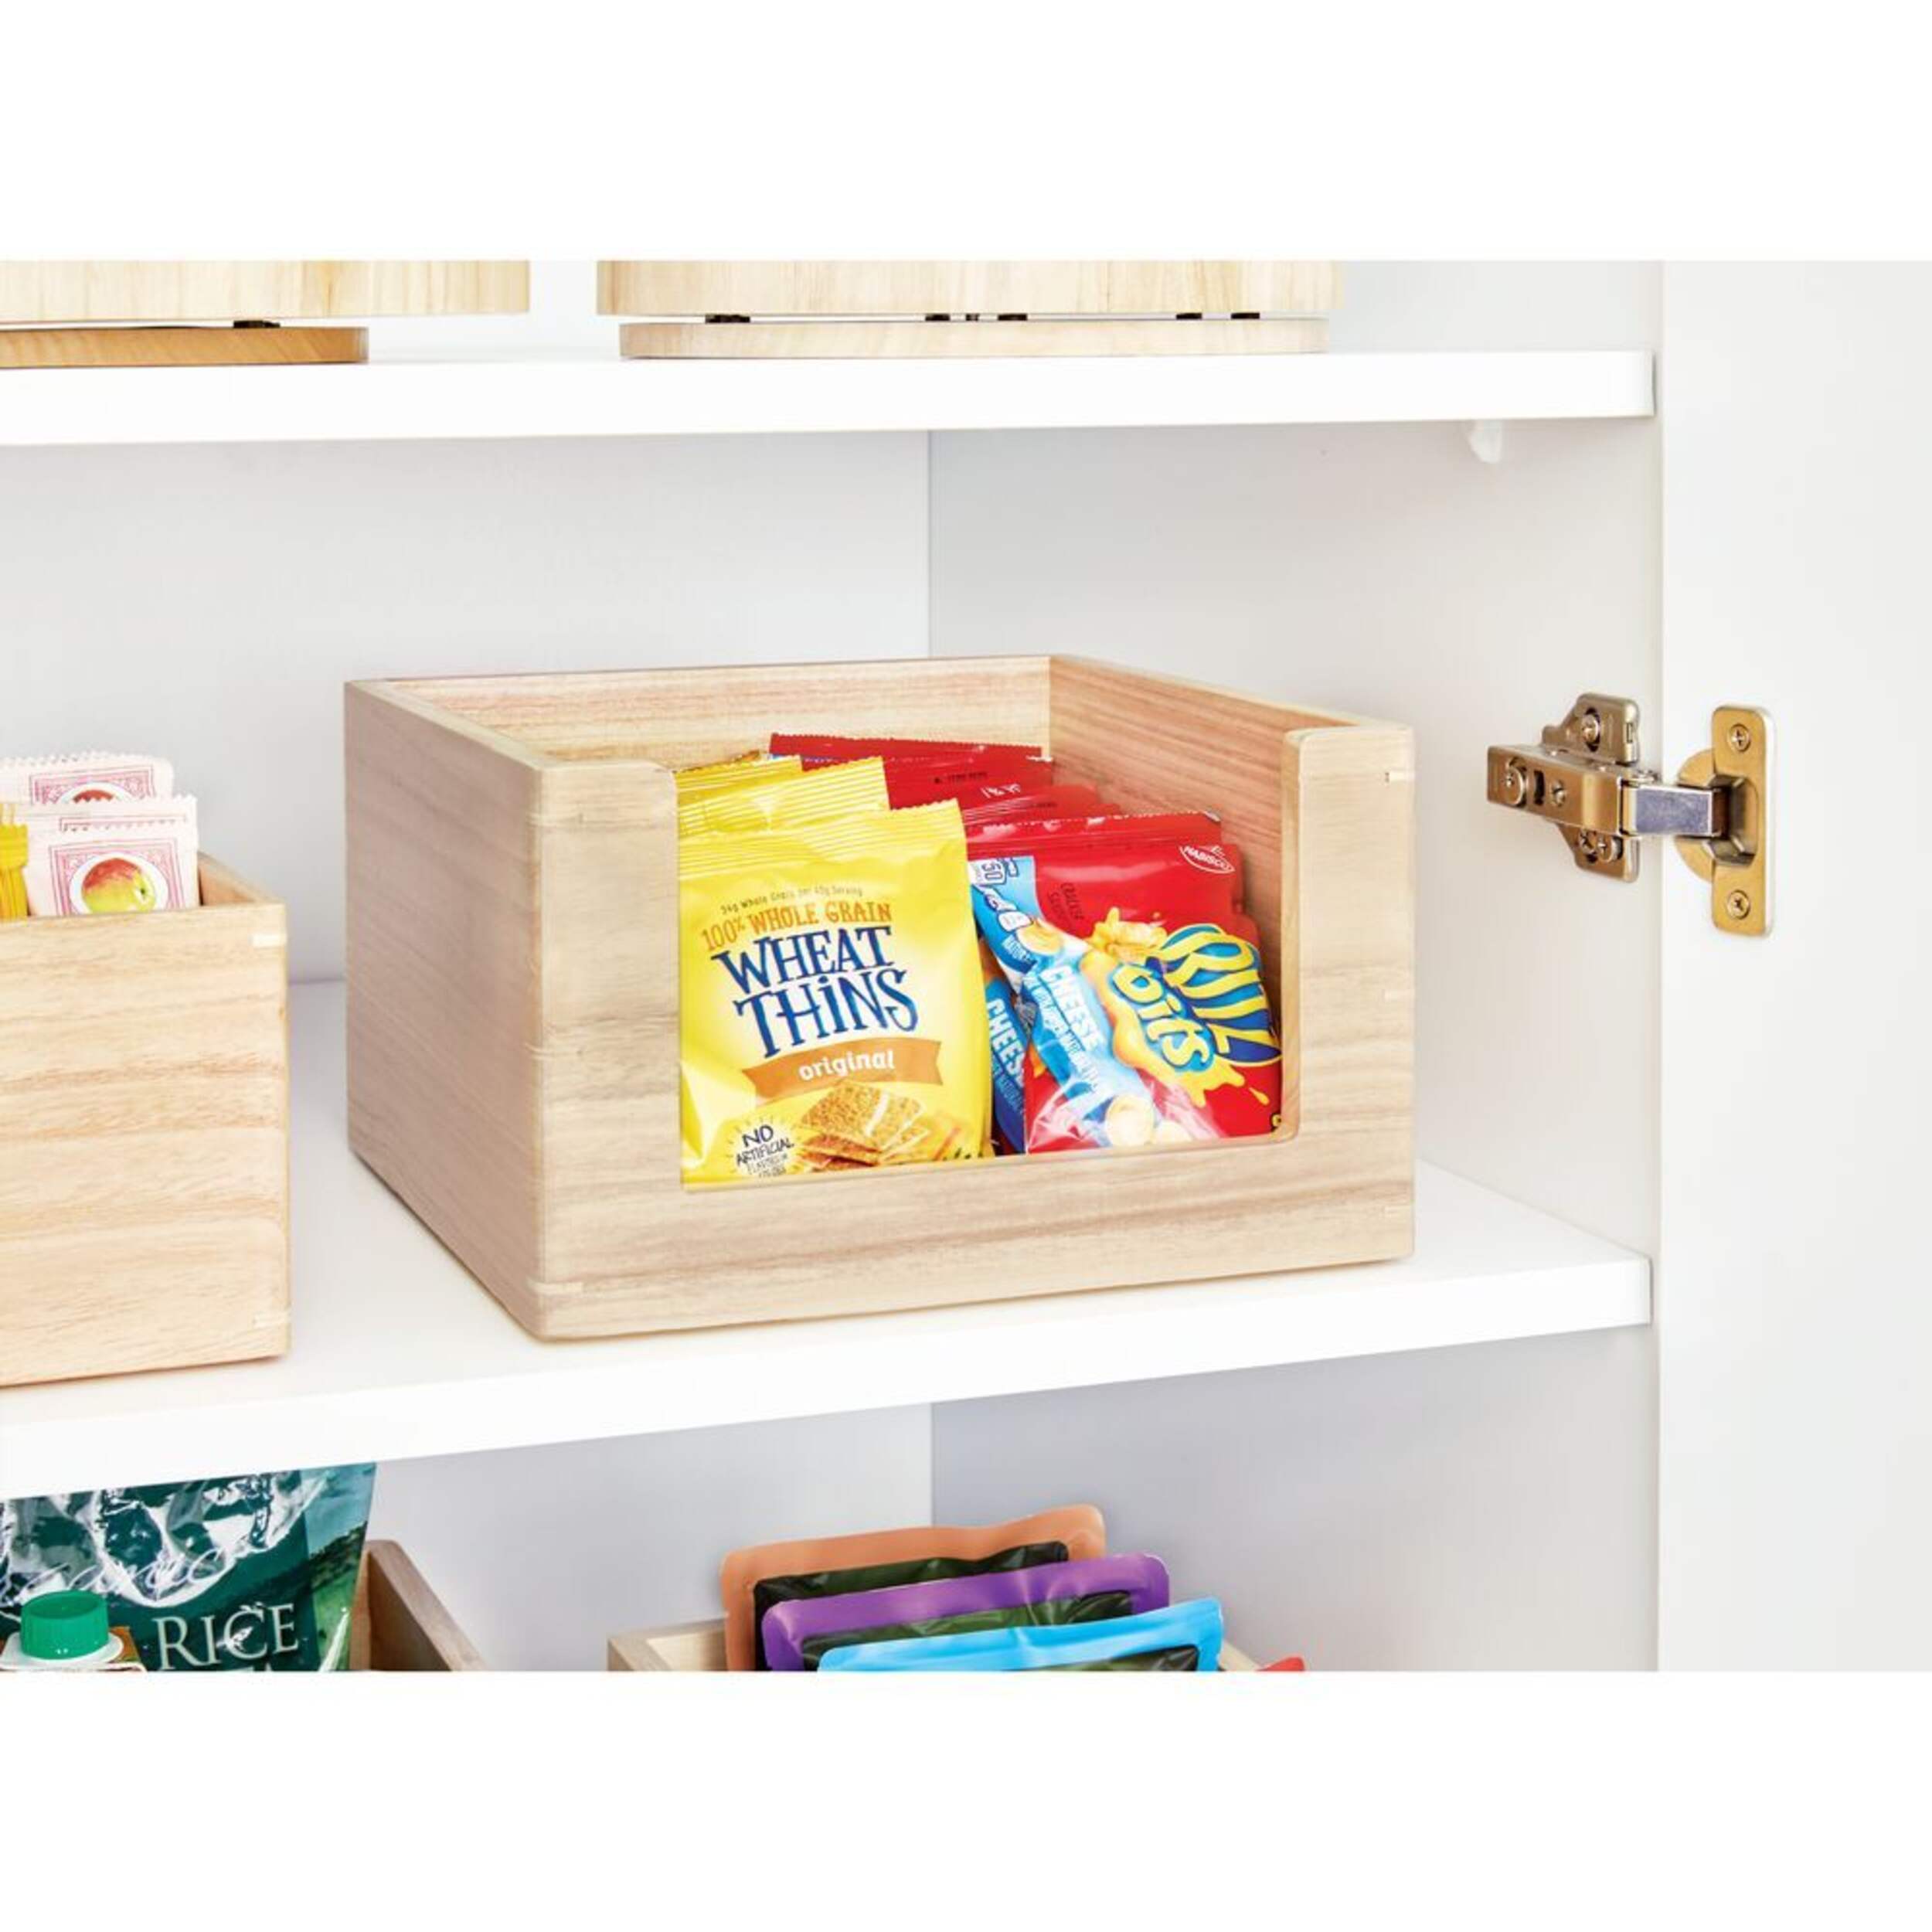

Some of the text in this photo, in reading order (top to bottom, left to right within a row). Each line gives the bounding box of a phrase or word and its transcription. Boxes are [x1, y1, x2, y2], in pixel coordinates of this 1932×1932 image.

[702, 900, 893, 951] 100% WHOLE GRAIN
[711, 926, 894, 995] WHEAT
[1039, 965, 1105, 1053] CHEESE
[1113, 964, 1210, 1068] bits
[799, 1049, 895, 1081] original
[736, 1137, 794, 1167] ARTIFICIAL
[742, 1124, 774, 1148] NO
[152, 1602, 299, 1671] RICE
